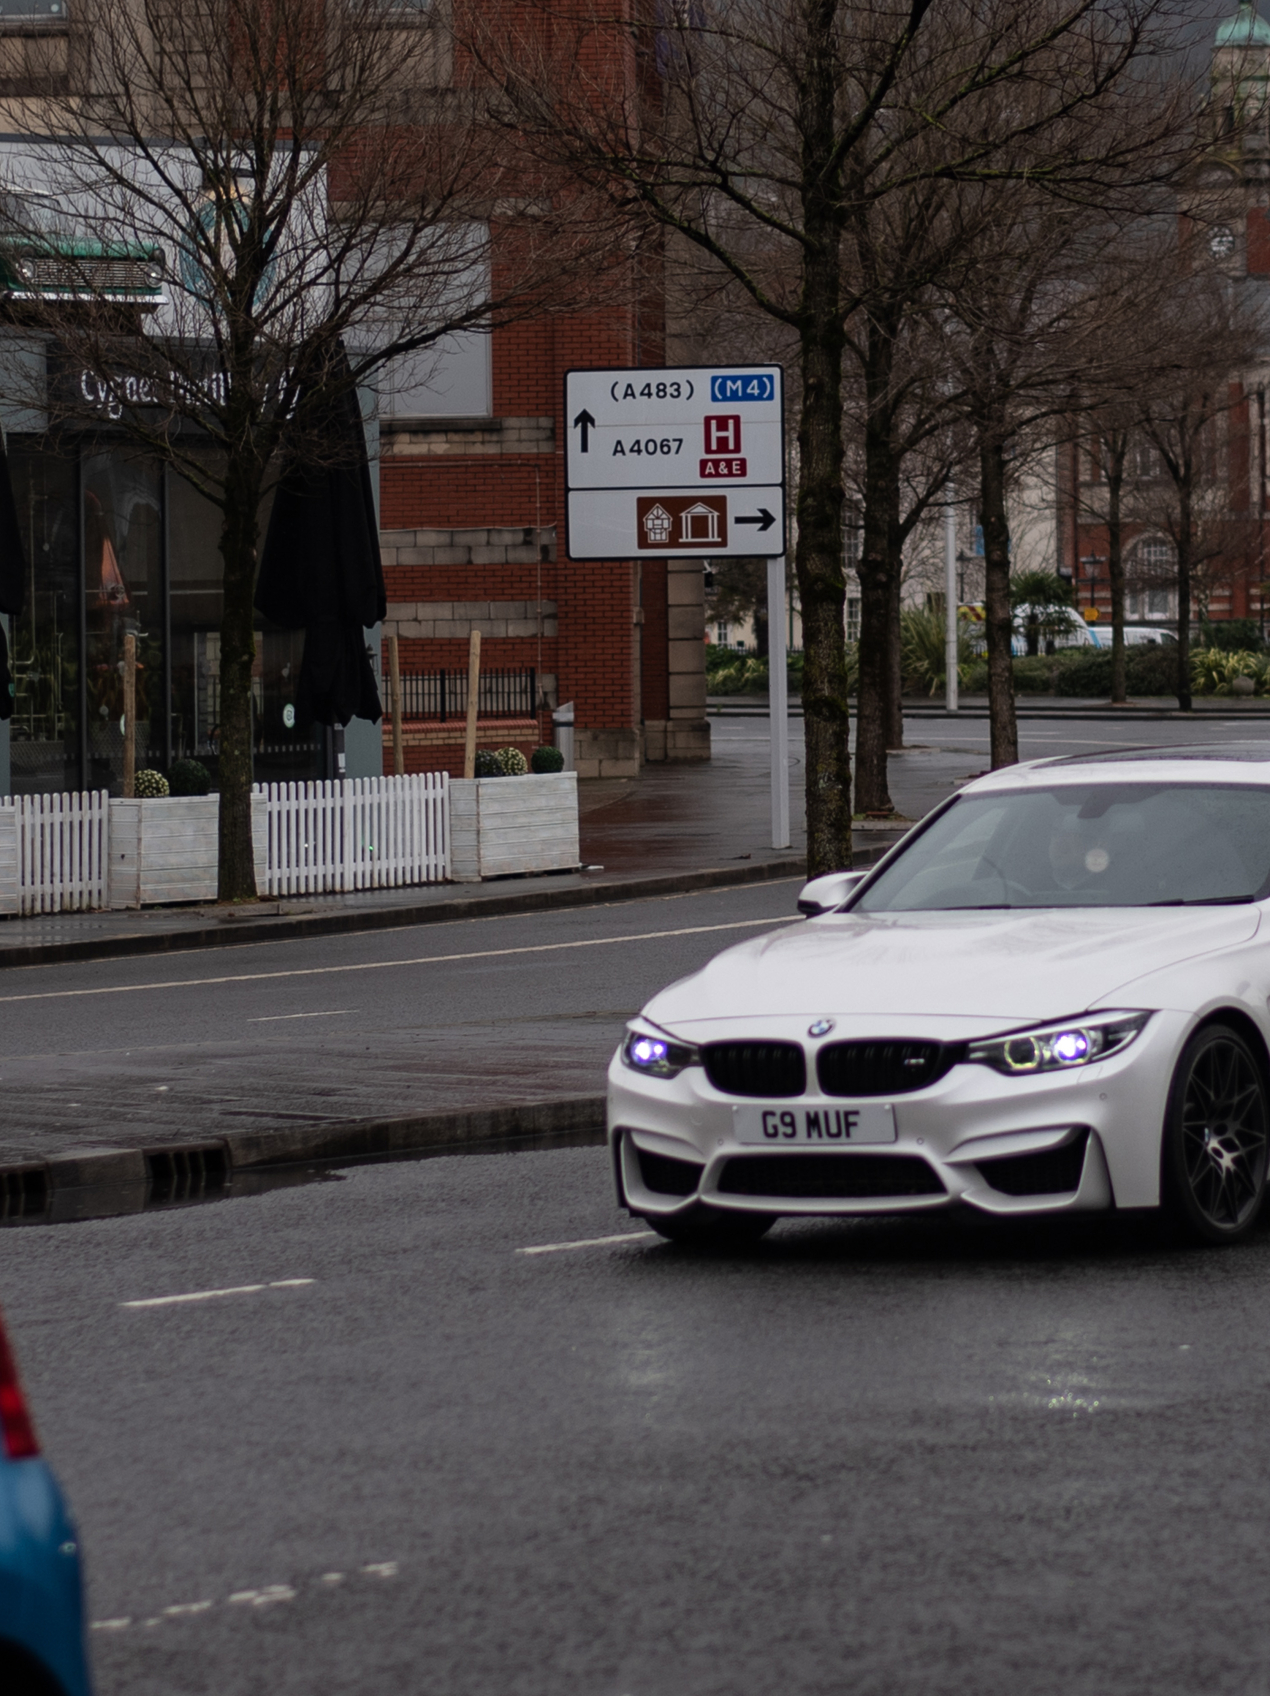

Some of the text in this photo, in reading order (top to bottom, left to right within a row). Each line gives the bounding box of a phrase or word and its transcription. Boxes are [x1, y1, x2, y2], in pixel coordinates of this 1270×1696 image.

[611, 376, 771, 402] (A483) (M4)
[612, 438, 684, 456] A4067
[710, 419, 734, 450] H
[762, 1109, 860, 1139] G9 MUF
